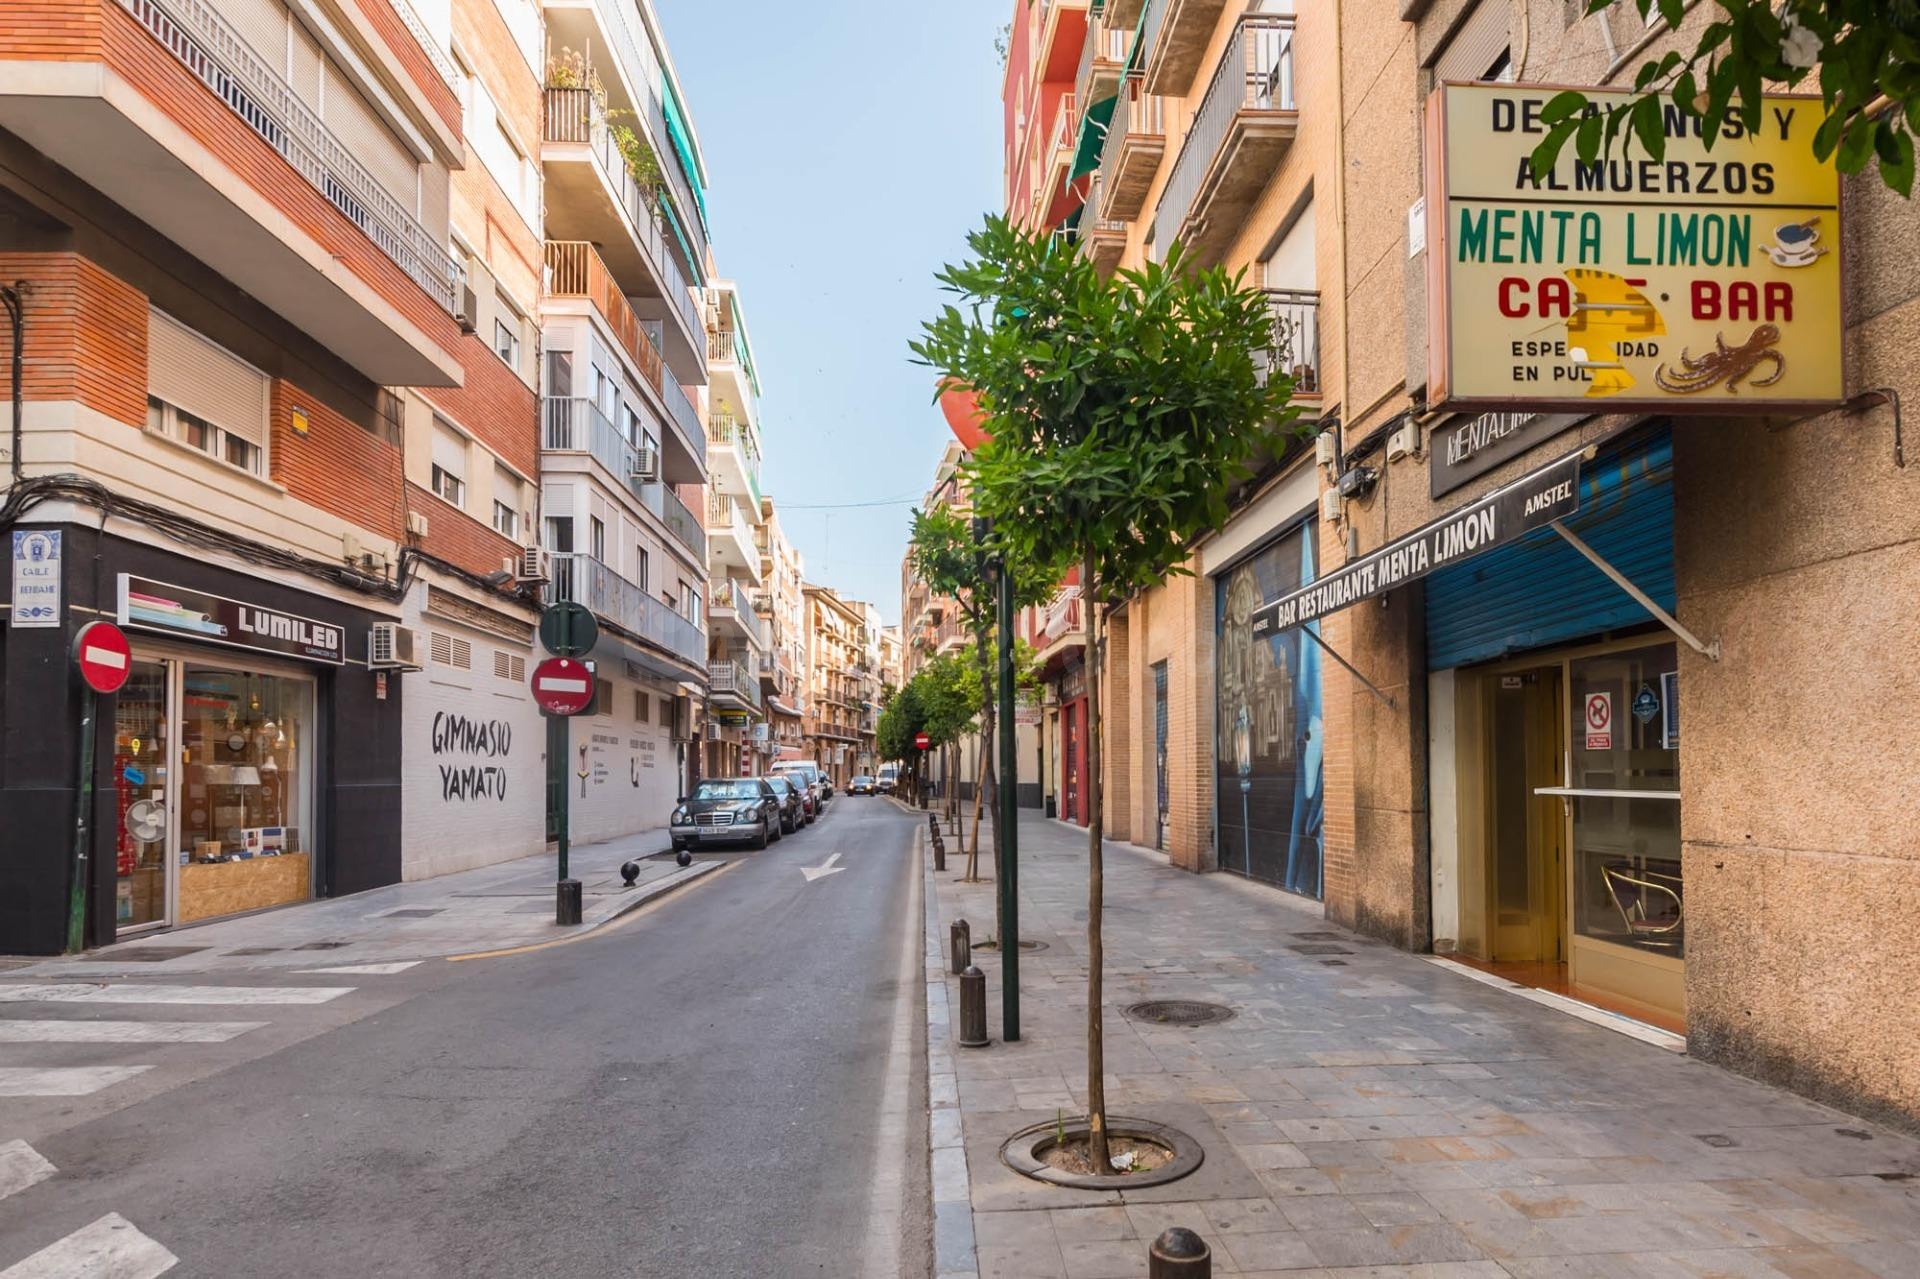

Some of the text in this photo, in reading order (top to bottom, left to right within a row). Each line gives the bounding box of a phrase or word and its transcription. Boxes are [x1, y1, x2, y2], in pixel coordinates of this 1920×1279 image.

[1773, 107, 1796, 142] Y
[1515, 156, 1776, 195] ALMUERZOS
[1458, 208, 1752, 268] MENTA LIMON
[1498, 276, 1794, 323] CA BAR
[1512, 365, 1594, 382] EN PUL
[1523, 480, 1573, 517] AMSTEL
[1278, 600, 1297, 629] BAR
[1298, 563, 1376, 621] RESTAURANTE
[1377, 538, 1429, 588] MENTA
[1434, 505, 1496, 564] LIMON
[238, 606, 338, 650] LUMILED
[432, 711, 511, 758] GIMNASIO
[438, 764, 506, 802] YAMATO
